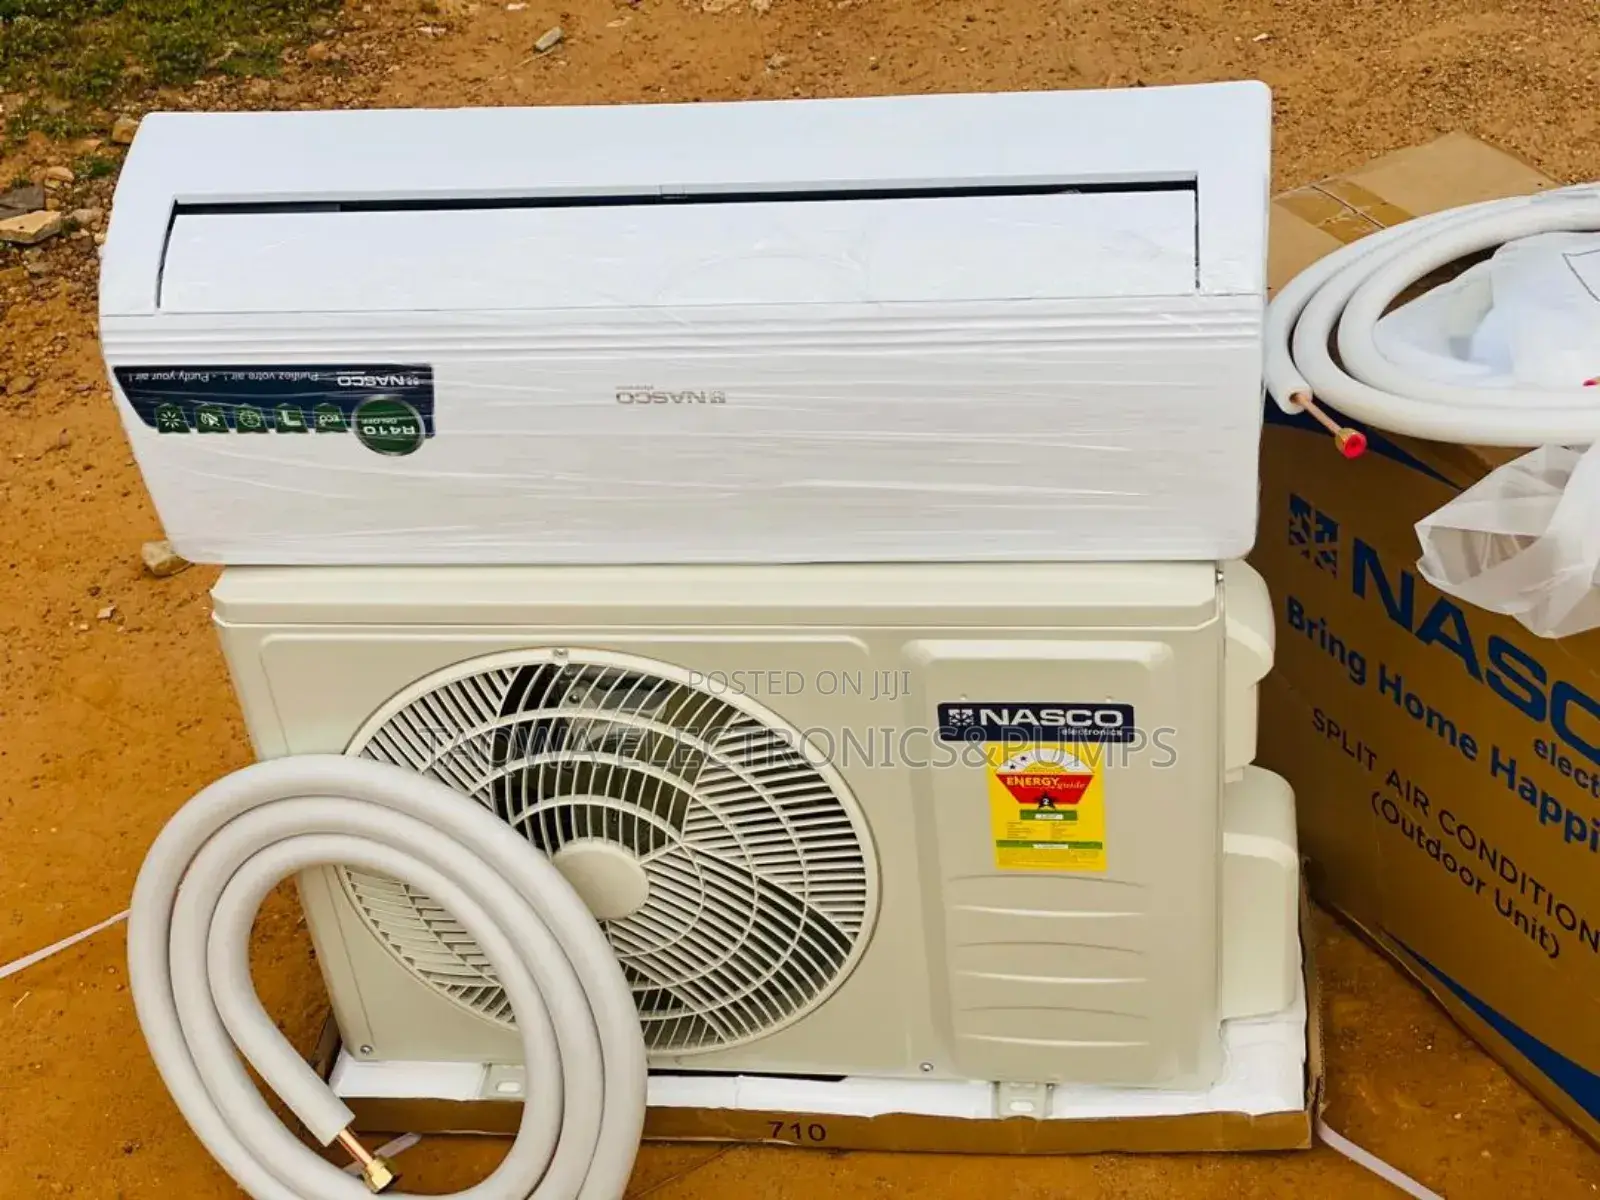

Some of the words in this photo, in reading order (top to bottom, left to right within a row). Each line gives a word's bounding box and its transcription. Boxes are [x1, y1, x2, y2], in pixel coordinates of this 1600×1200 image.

[135, 372, 149, 381] air
[152, 370, 175, 381] your
[178, 370, 210, 383] Purify
[231, 371, 245, 381] air
[249, 371, 275, 381] votre
[337, 375, 404, 387] NASCO
[615, 390, 706, 404] NASCO
[363, 425, 416, 435] R410
[979, 708, 1124, 727] NASCO
[1287, 595, 1367, 686] Bring
[1378, 661, 1478, 761] Home
[1490, 743, 1600, 853] Happi
[1061, 728, 1123, 736] electronics
[1534, 737, 1600, 798] elect
[1006, 776, 1061, 787] ENERGY
[1311, 707, 1377, 771] SPLIT
[1385, 769, 1430, 818] AIR
[1438, 809, 1600, 954] CONDITION
[1371, 791, 1486, 895] (Outdoor
[1495, 886, 1560, 959] Unit)
[766, 1121, 827, 1141] 710
